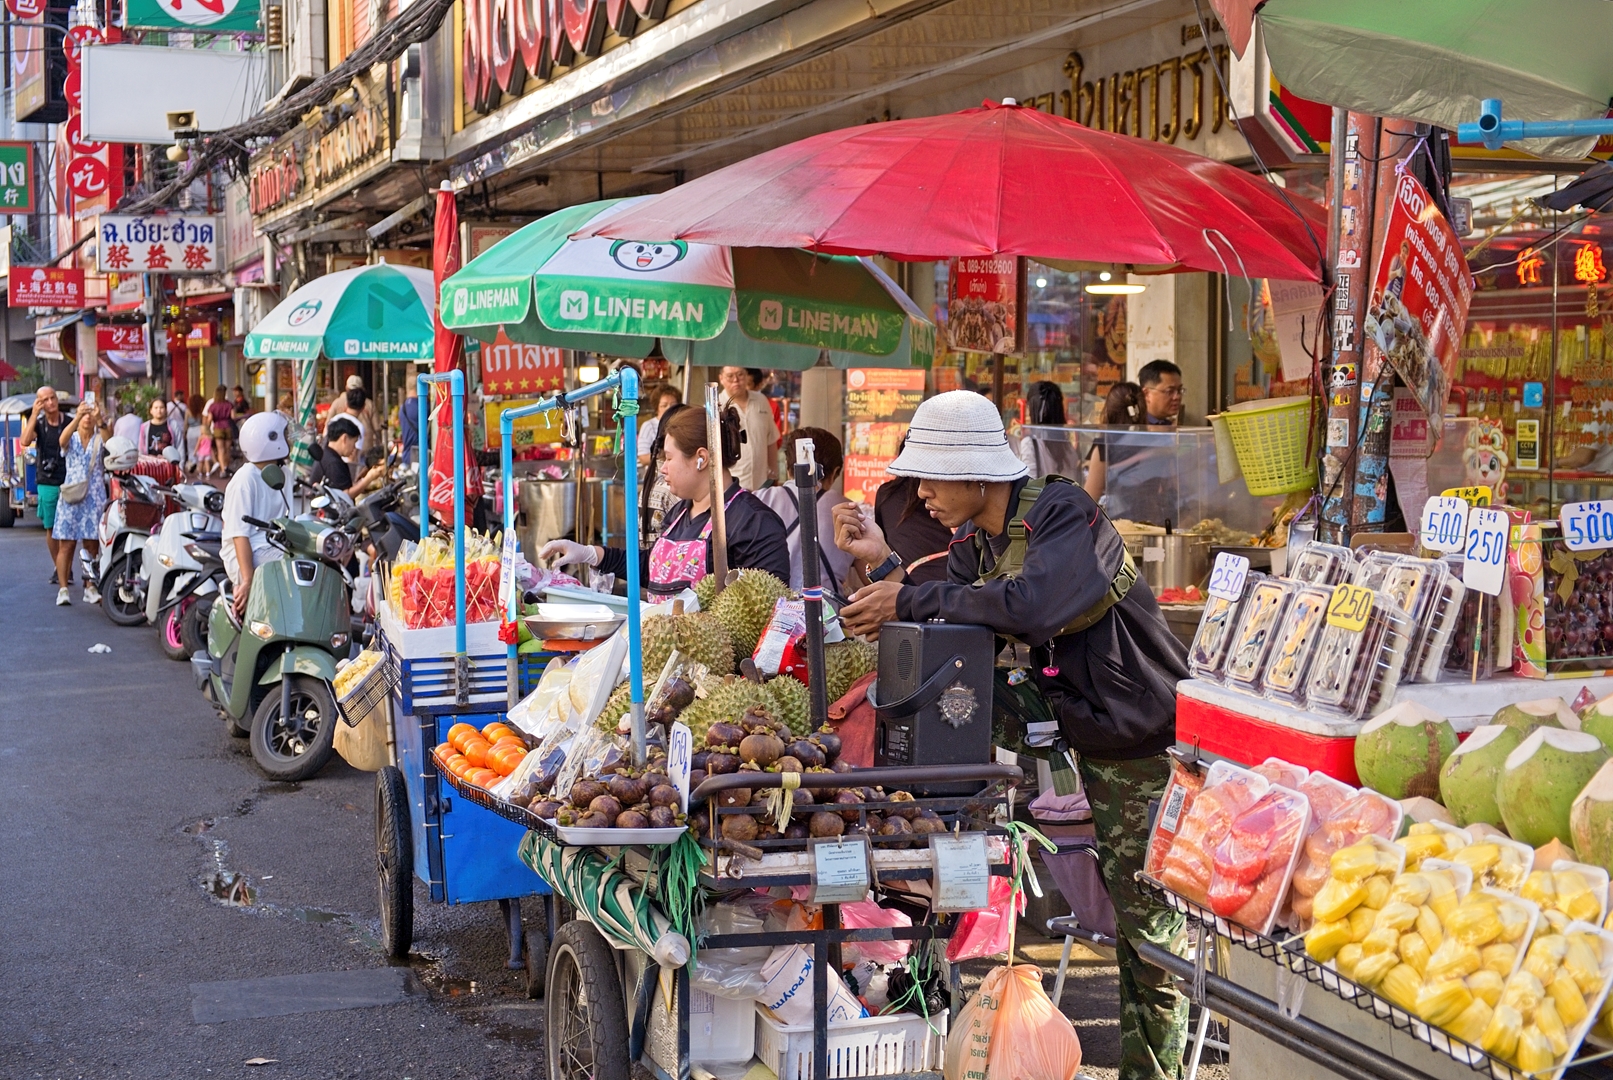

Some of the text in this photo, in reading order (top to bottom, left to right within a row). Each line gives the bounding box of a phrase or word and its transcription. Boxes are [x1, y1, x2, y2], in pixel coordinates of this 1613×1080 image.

[967, 259, 1013, 274] 089-2192600
[1439, 498, 1443, 508] 1
[1579, 504, 1585, 512] 1
[1427, 512, 1462, 545] 500
[1570, 512, 1613, 545] 500
[1467, 528, 1504, 565] 250
[1210, 567, 1244, 595] 250
[1331, 585, 1371, 622] 250
